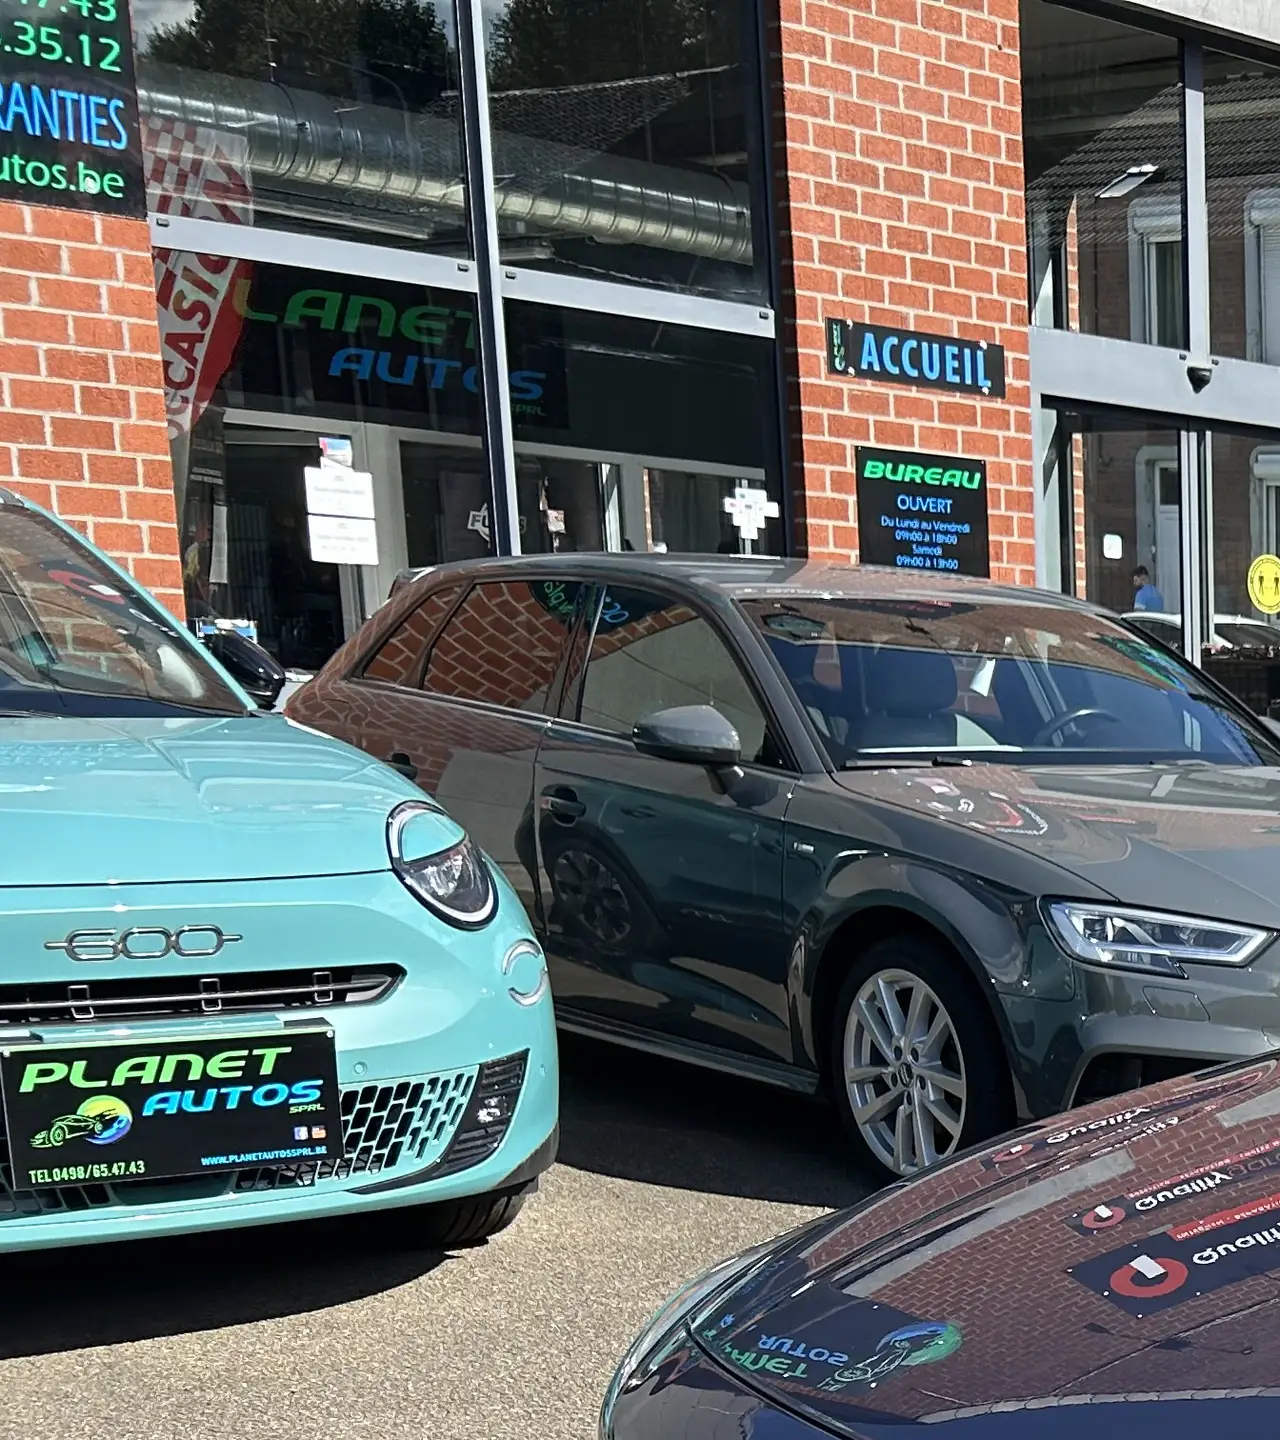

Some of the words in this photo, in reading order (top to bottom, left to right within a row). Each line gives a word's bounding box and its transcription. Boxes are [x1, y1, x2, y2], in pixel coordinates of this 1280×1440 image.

[860, 332, 992, 388] ACCUEIL
[863, 459, 981, 490] BUREAU
[897, 493, 953, 515] OUVERT
[64, 924, 225, 962] 600
[18, 1046, 292, 1094] PLANET
[142, 1079, 324, 1117] AUTOS
[289, 1103, 326, 1115] SPRL
